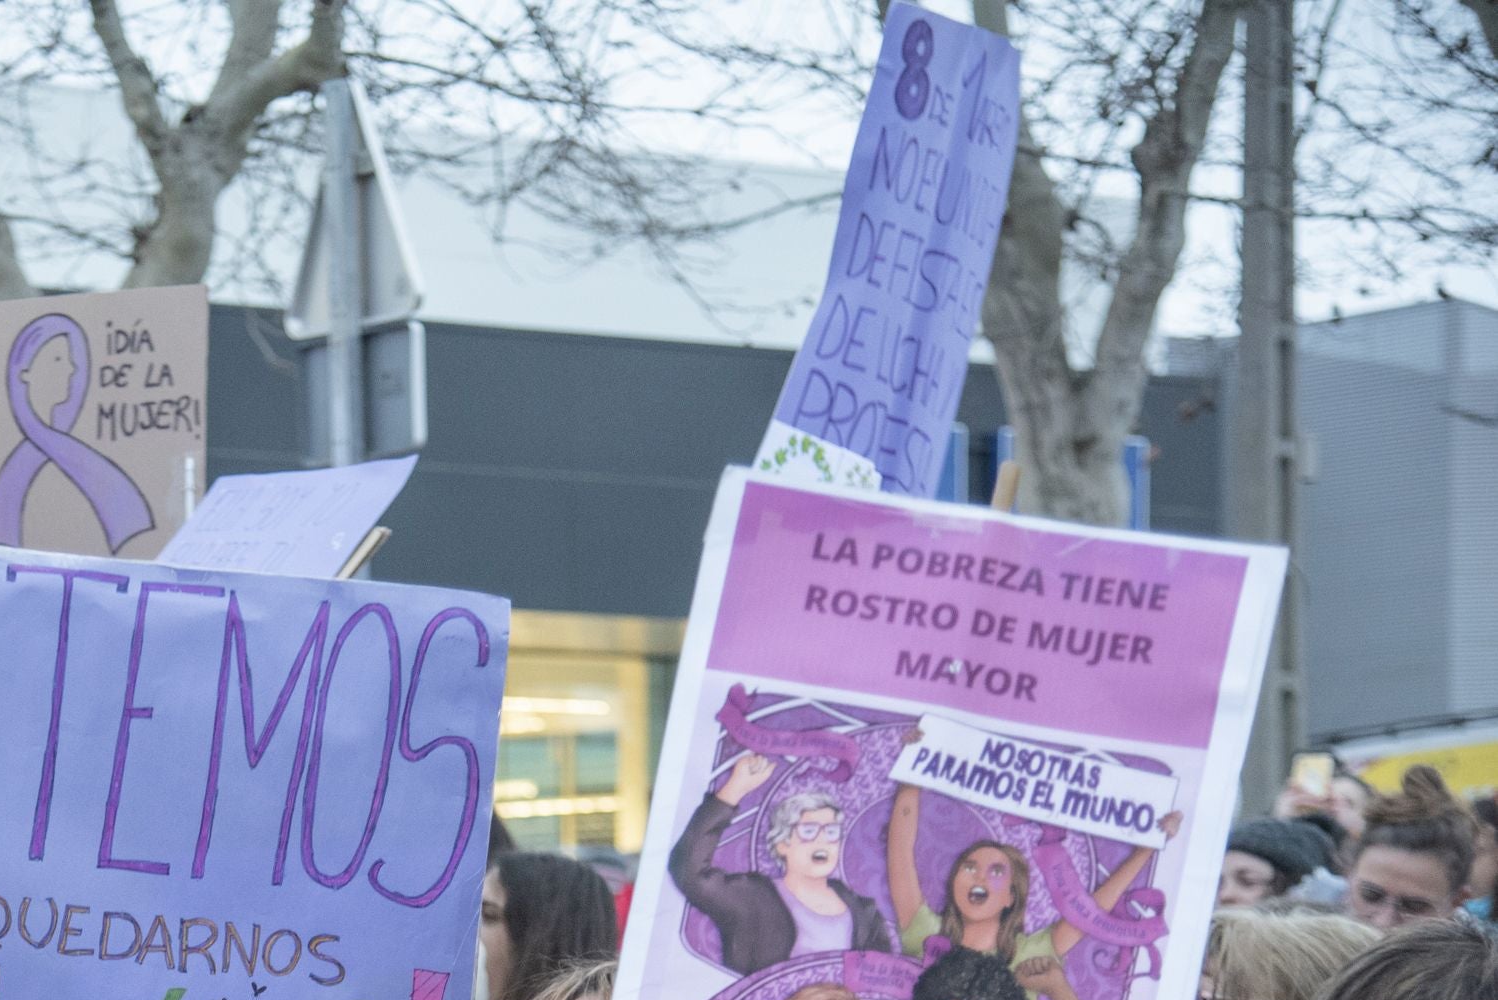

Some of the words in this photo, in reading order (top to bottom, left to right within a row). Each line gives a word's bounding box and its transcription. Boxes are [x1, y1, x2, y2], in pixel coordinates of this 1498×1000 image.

[815, 294, 877, 374] DE
[99, 363, 130, 389] DE
[144, 362, 174, 388] LA
[96, 395, 201, 442] MUJER!
[811, 532, 859, 566] LA
[871, 542, 1046, 597] POBREZA
[1060, 571, 1171, 612] TIENE
[803, 584, 961, 632] ROSTRO
[969, 609, 1018, 645] DE
[1026, 621, 1155, 667] MUJER
[893, 650, 1039, 702] MAYOR
[979, 737, 1102, 790] NOSOTRAS
[1029, 780, 1056, 812] EL
